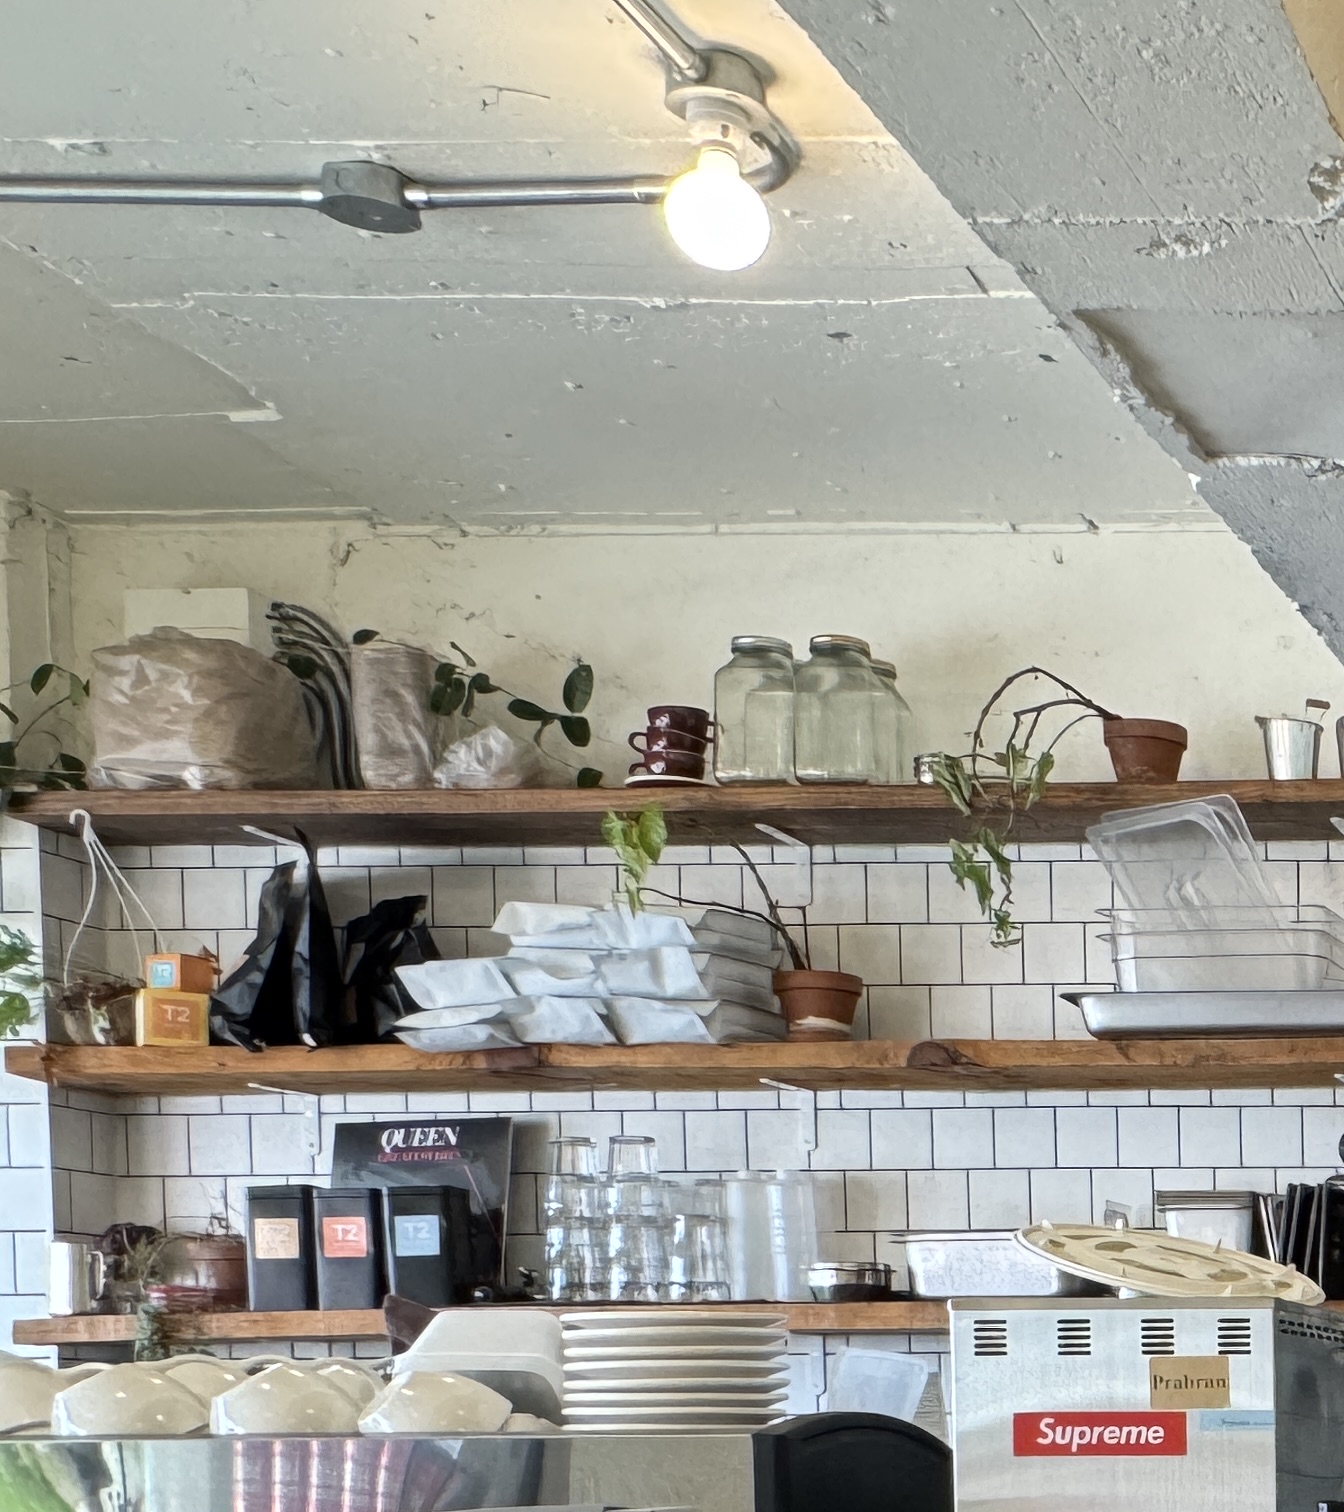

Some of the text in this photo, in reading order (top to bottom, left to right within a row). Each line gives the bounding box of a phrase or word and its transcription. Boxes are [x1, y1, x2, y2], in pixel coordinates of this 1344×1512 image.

[160, 1004, 190, 1022] T2
[381, 1126, 460, 1153] QUEEN
[332, 1224, 358, 1242] T2
[403, 1222, 433, 1240] T2
[1036, 1417, 1164, 1452] Supreme
